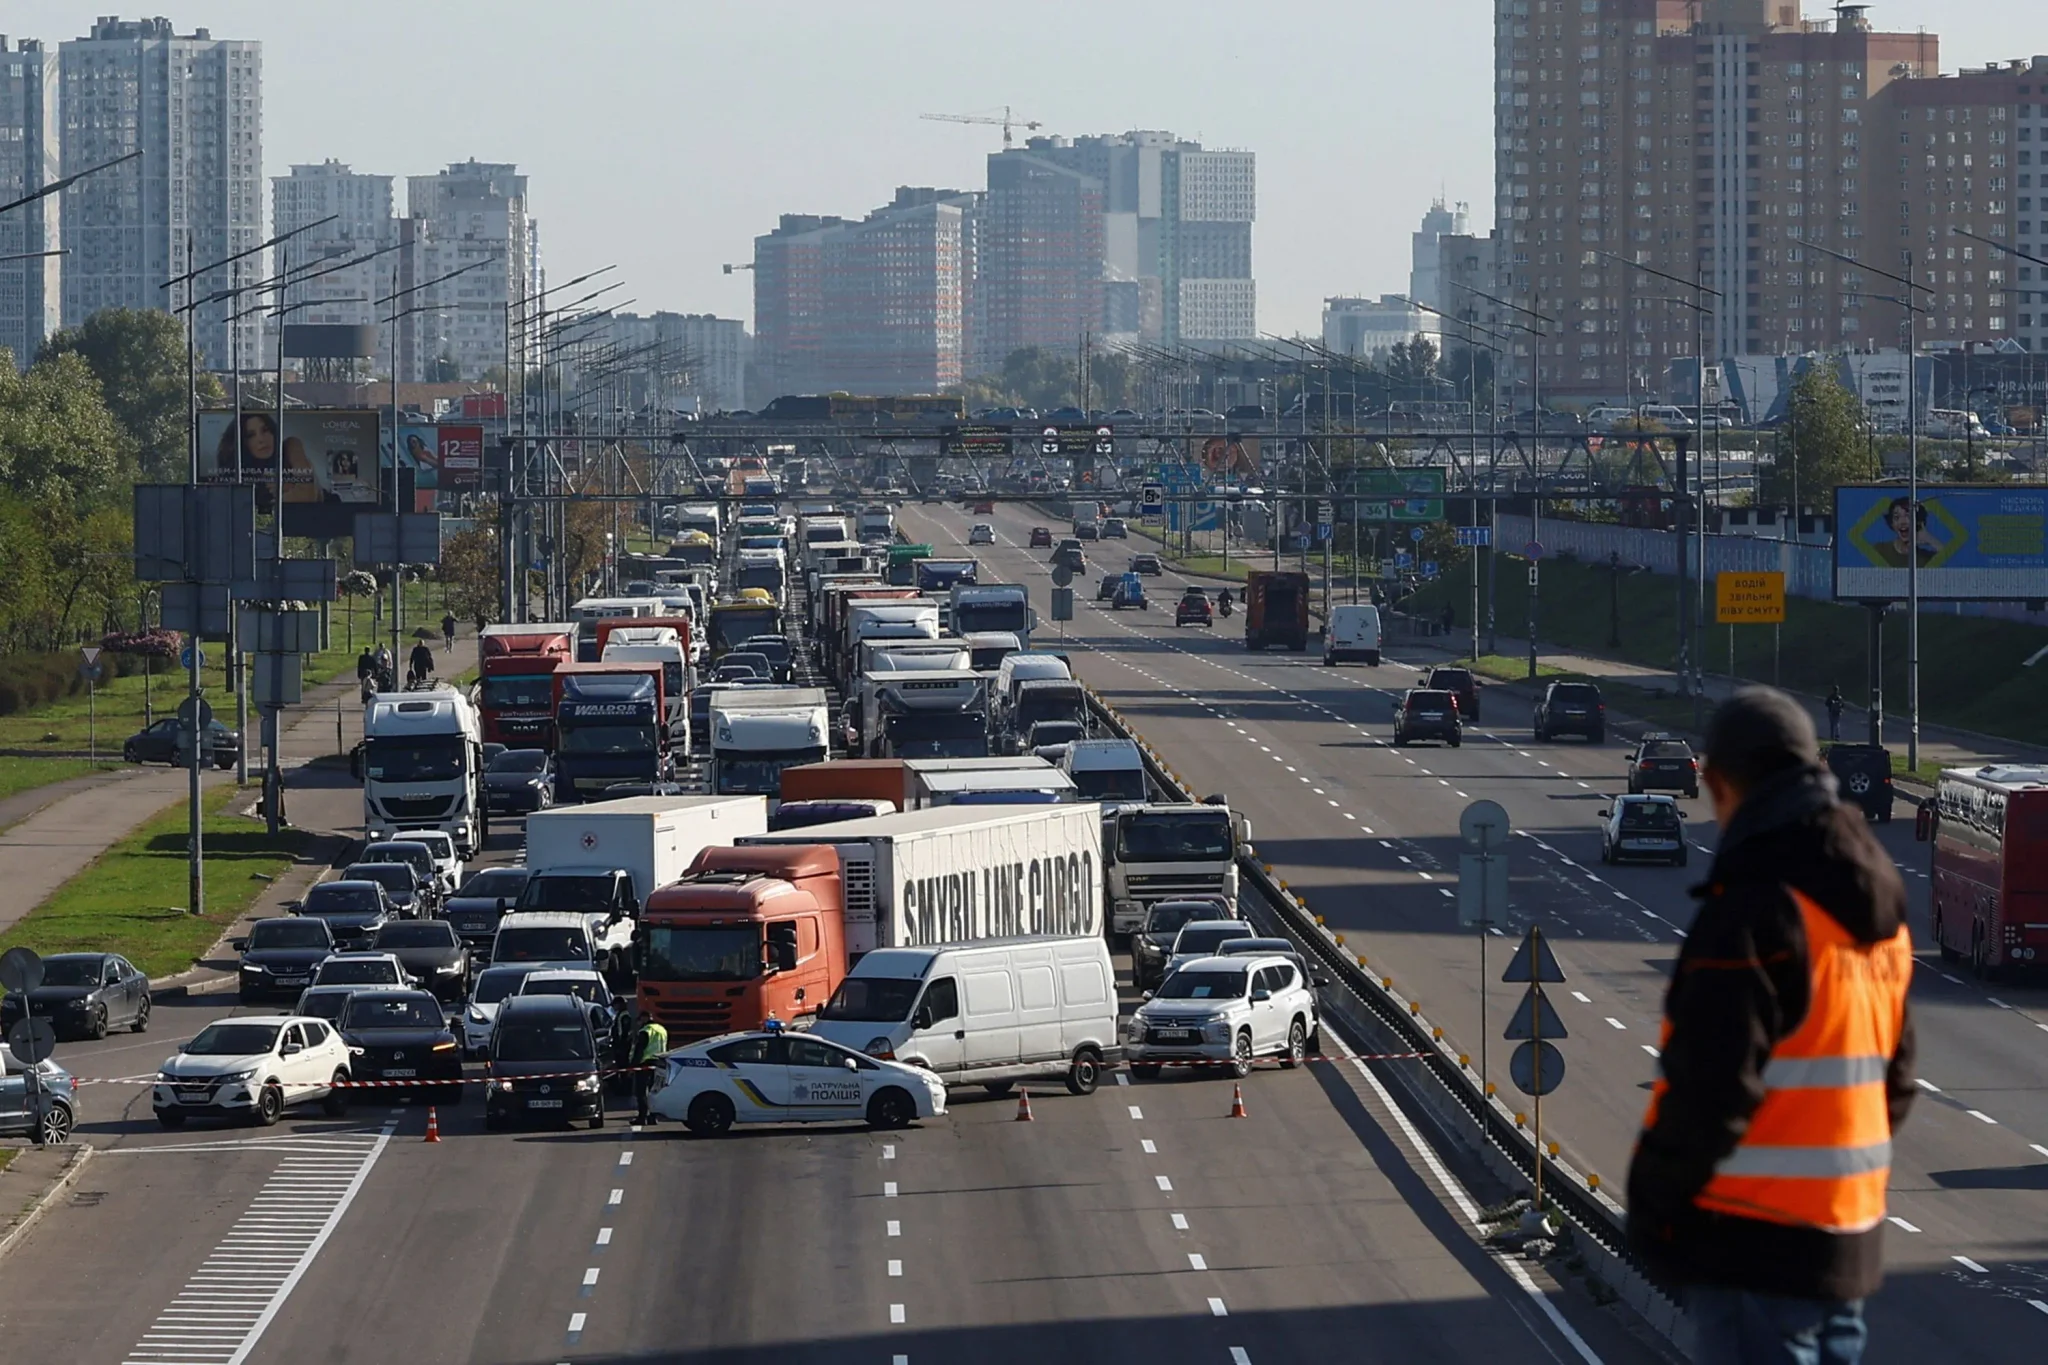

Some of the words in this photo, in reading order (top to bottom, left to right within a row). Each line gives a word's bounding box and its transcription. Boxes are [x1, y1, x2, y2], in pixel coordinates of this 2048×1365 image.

[441, 440, 460, 455] 12
[1734, 577, 1766, 589] ВОДІЙ
[1728, 593, 1773, 602] ЗВІЛЬНИ
[1719, 606, 1744, 615] ЛІВУ
[1747, 606, 1781, 615] СМУГУ
[575, 704, 637, 715] WALDOR
[903, 871, 978, 946] SMYRIL
[984, 862, 1025, 938] LINE
[1028, 850, 1093, 935] CARGO
[811, 1090, 861, 1100] ПОЛІЦІЯ
